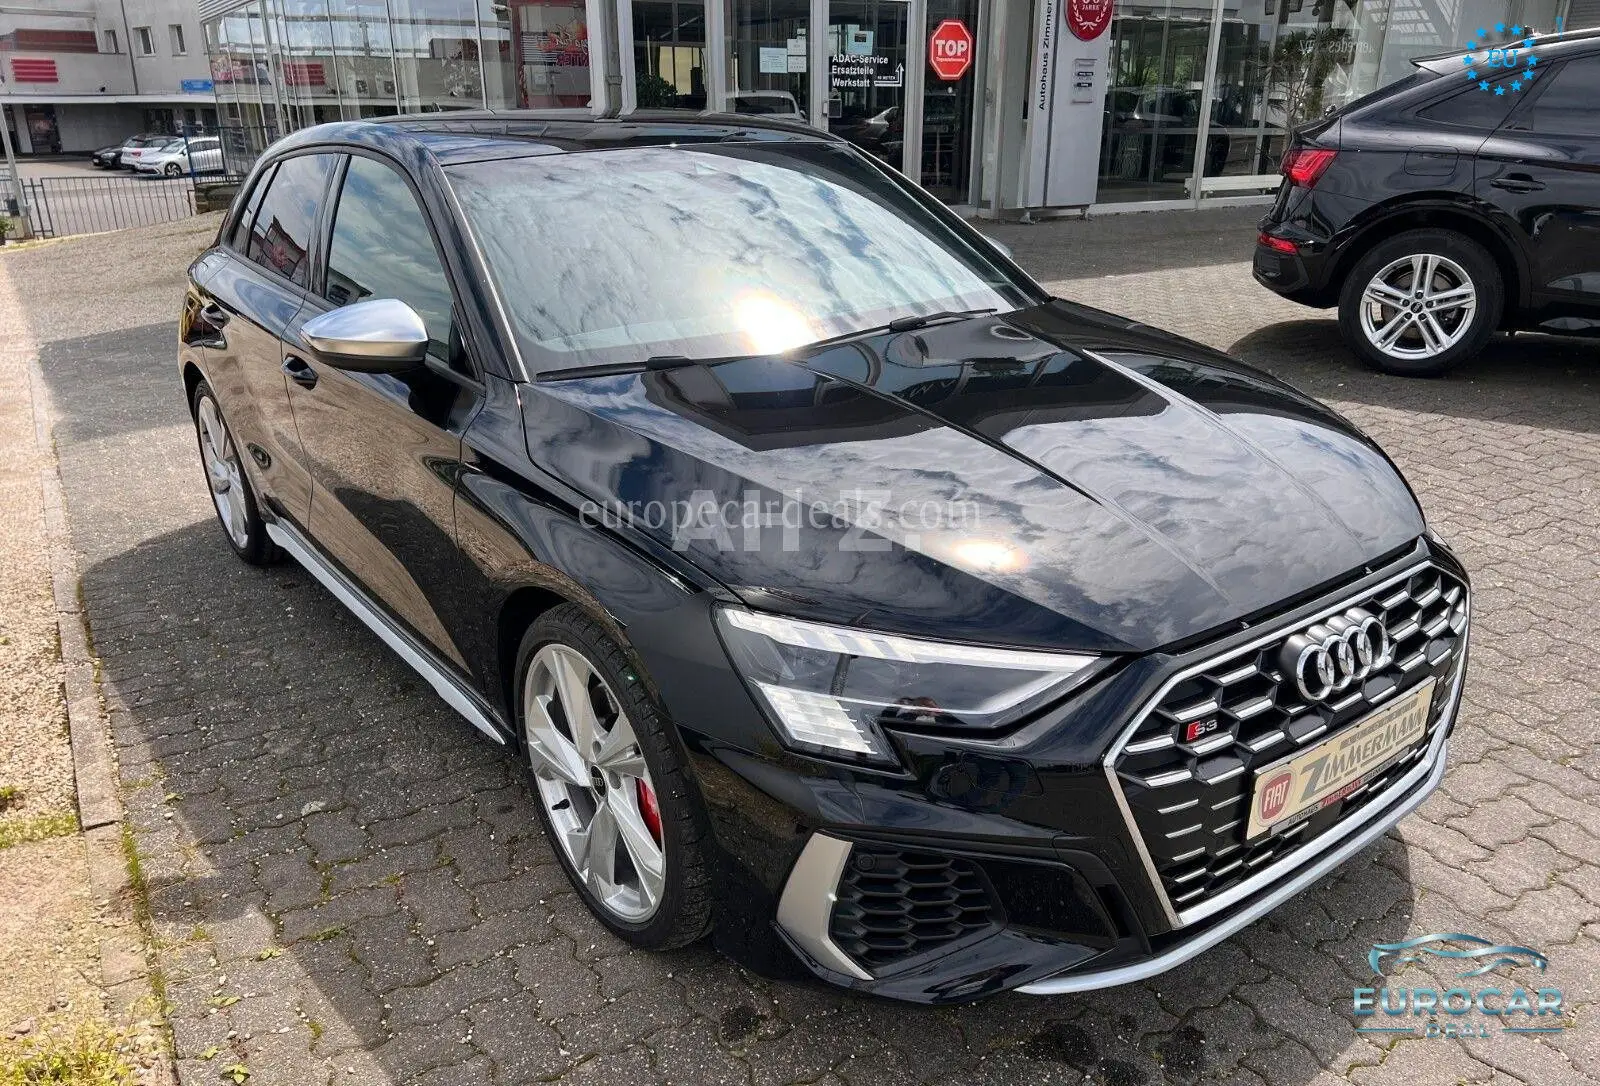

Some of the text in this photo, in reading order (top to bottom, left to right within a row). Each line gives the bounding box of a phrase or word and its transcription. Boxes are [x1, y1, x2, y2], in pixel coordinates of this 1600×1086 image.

[935, 39, 968, 56] TOP
[832, 54, 889, 65] ADAC-Service
[832, 65, 874, 75] Ersatzteile
[832, 77, 871, 87] Werkstatt
[1039, 53, 1048, 110] Autohaus
[1193, 718, 1218, 736] S3
[1300, 707, 1427, 804] ZIMMERMANN
[1263, 778, 1290, 813] FIAT
